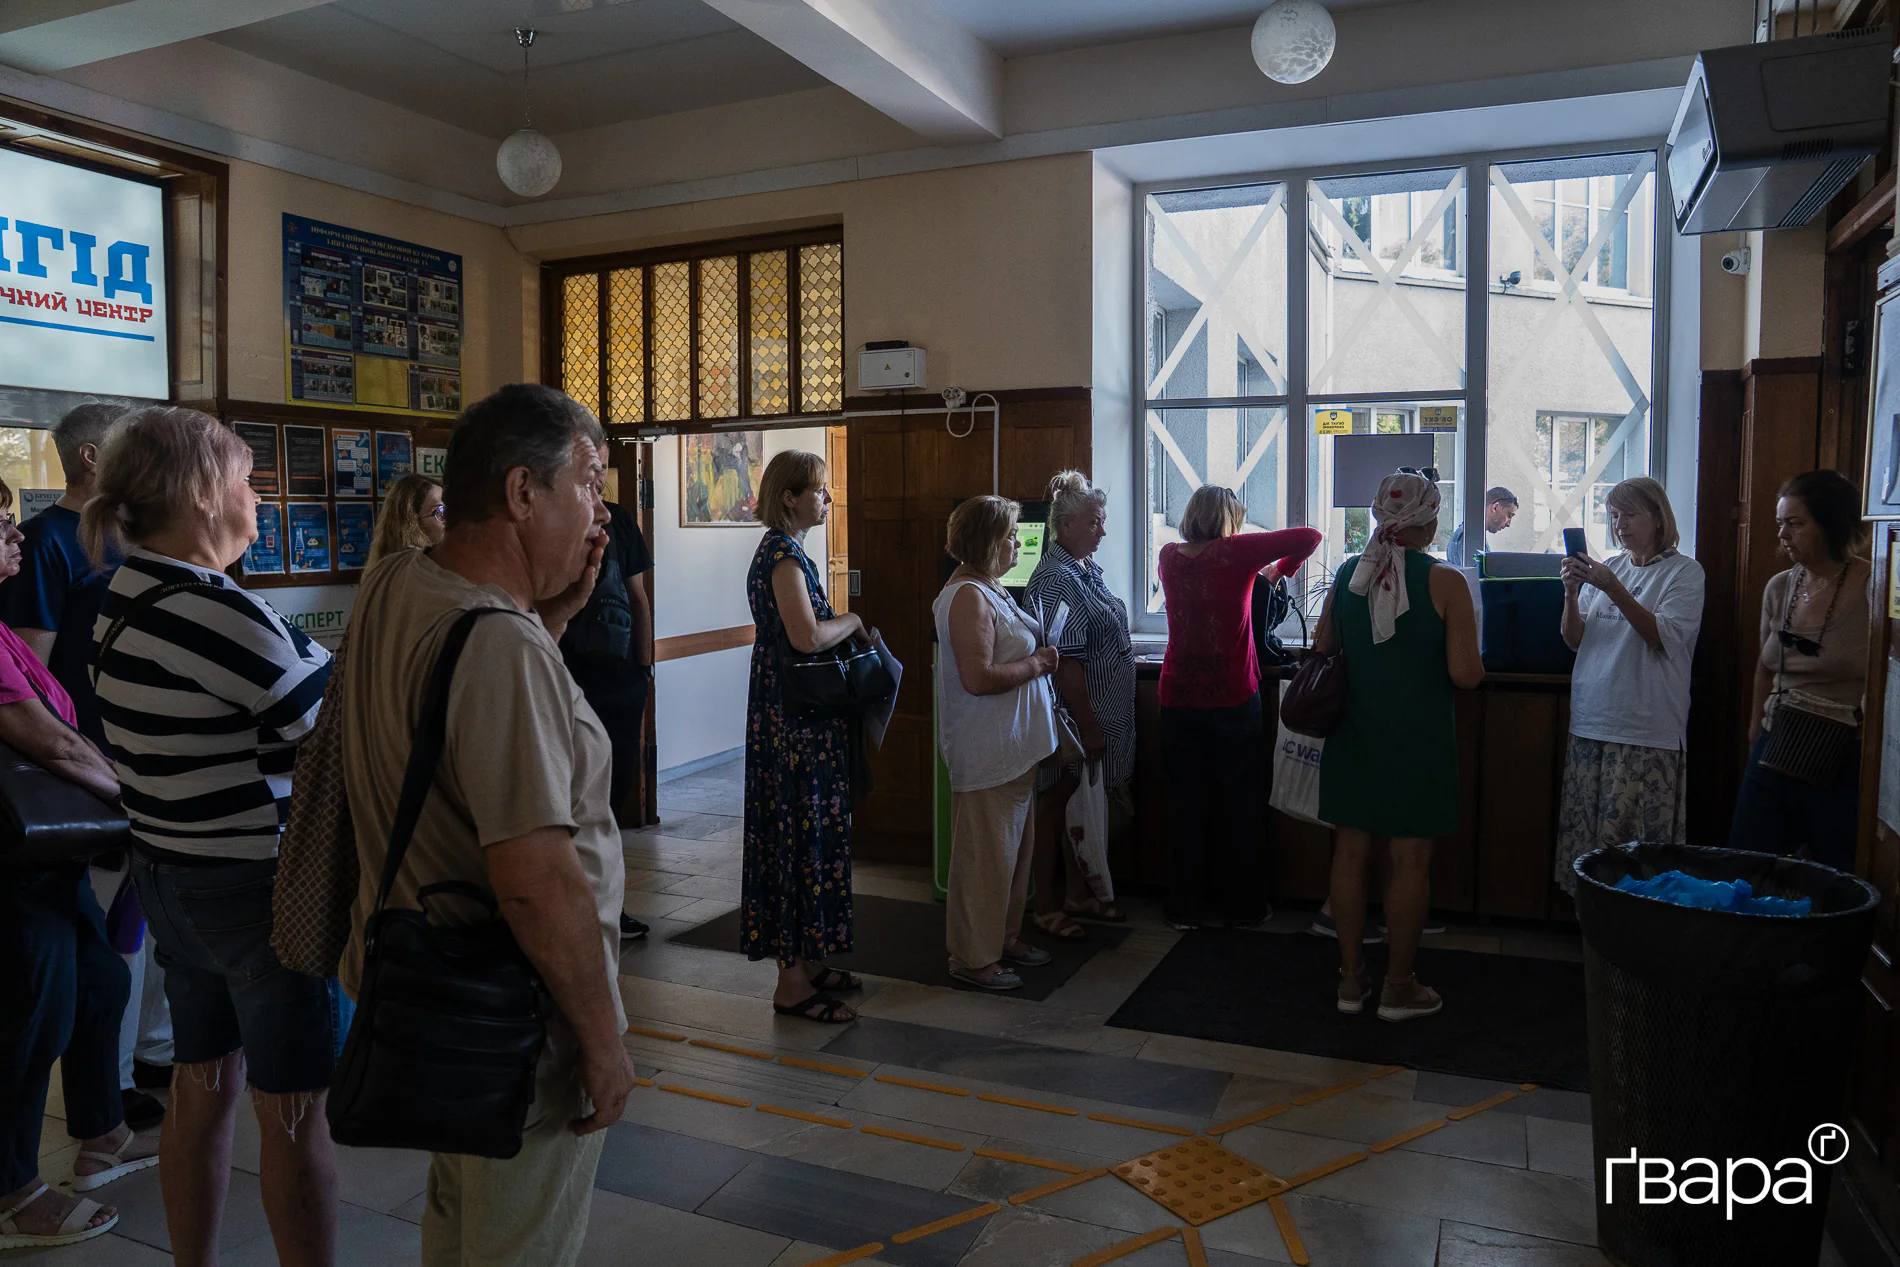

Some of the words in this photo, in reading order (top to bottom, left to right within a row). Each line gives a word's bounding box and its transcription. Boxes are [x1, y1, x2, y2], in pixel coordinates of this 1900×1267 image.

[0, 216, 152, 305] ГІД
[76, 298, 153, 323] ЦЕНТР
[1595, 611, 1617, 620] Mission
